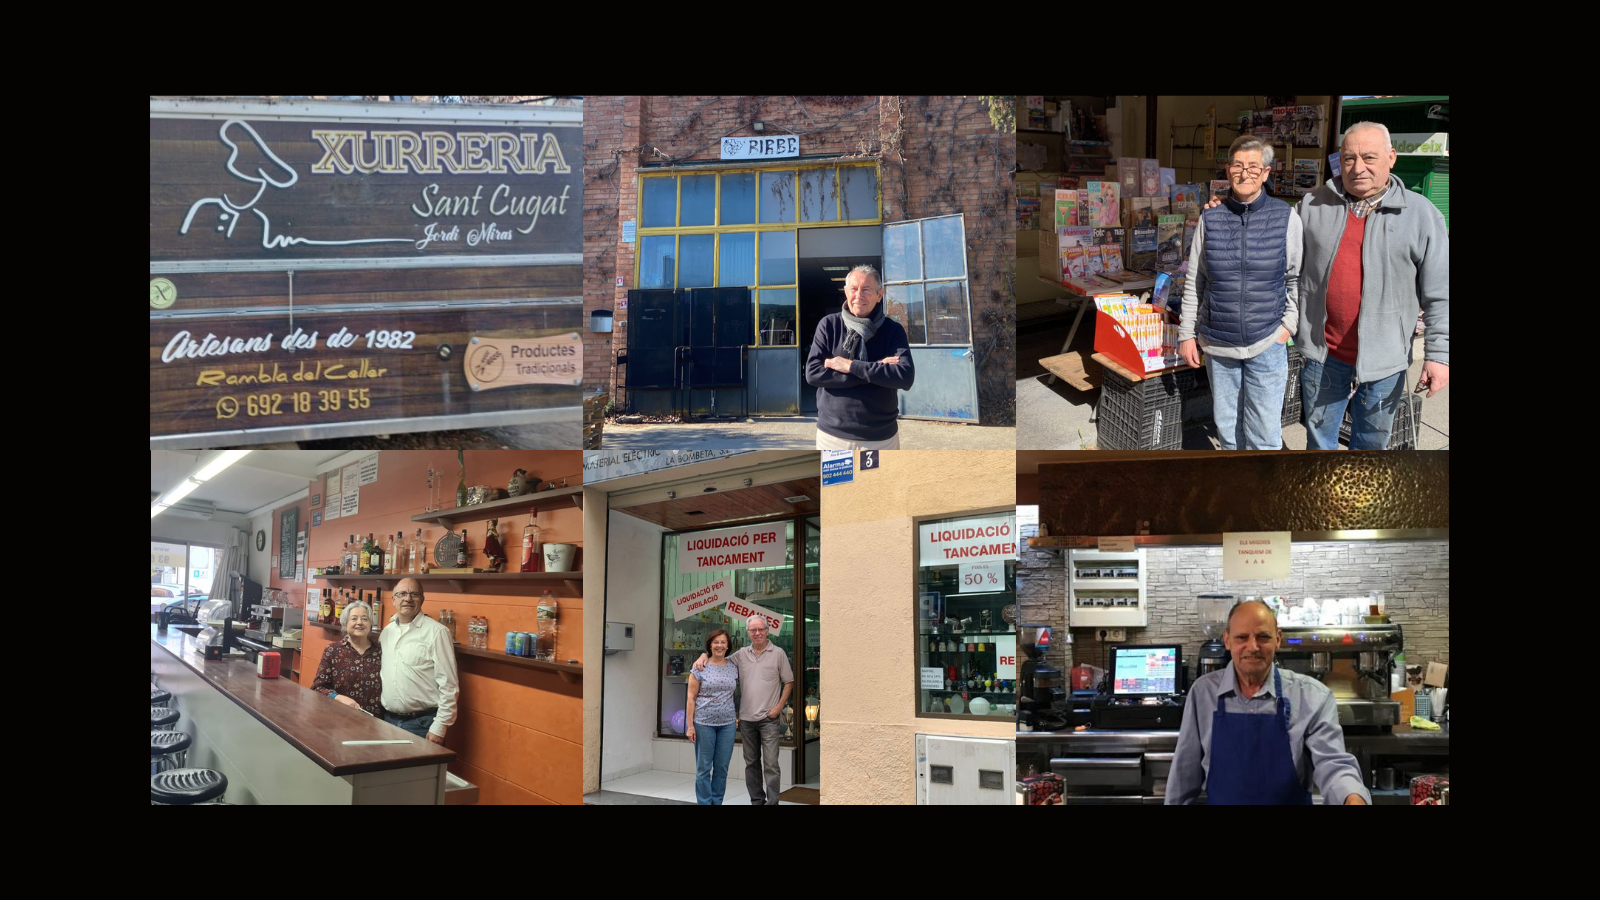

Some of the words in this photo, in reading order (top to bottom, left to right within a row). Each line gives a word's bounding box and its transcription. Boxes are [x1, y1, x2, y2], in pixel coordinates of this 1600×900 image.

[311, 130, 571, 174] XURRERIA
[412, 183, 483, 217] Sant
[489, 184, 571, 234] Cugat
[415, 222, 459, 249] Jordi
[467, 222, 513, 247] Miras
[161, 330, 273, 364] Artesans
[281, 328, 319, 351] des
[326, 326, 359, 348] de
[365, 330, 416, 349] 1982
[511, 344, 576, 358] Productes
[196, 362, 288, 387] Rambla
[292, 361, 320, 381] del
[324, 358, 388, 380] Celler
[515, 361, 576, 375] Tradicionals
[247, 394, 283, 417] 692
[292, 391, 312, 413] 18
[318, 390, 341, 412] 39
[348, 388, 371, 410] 55
[666, 458, 675, 466] LA
[865, 451, 873, 468] 3
[687, 532, 750, 551] LIQUIDACIÓ
[753, 531, 776, 544] PER
[930, 522, 1010, 543] LIQUIDACIÓ
[697, 551, 765, 567] TANCAMENT
[964, 573, 983, 586] 50
[987, 573, 998, 584] %
[676, 585, 711, 606] LIQUIDACIÓ
[711, 581, 724, 592] PER
[687, 594, 719, 612] JUBILACIÓ
